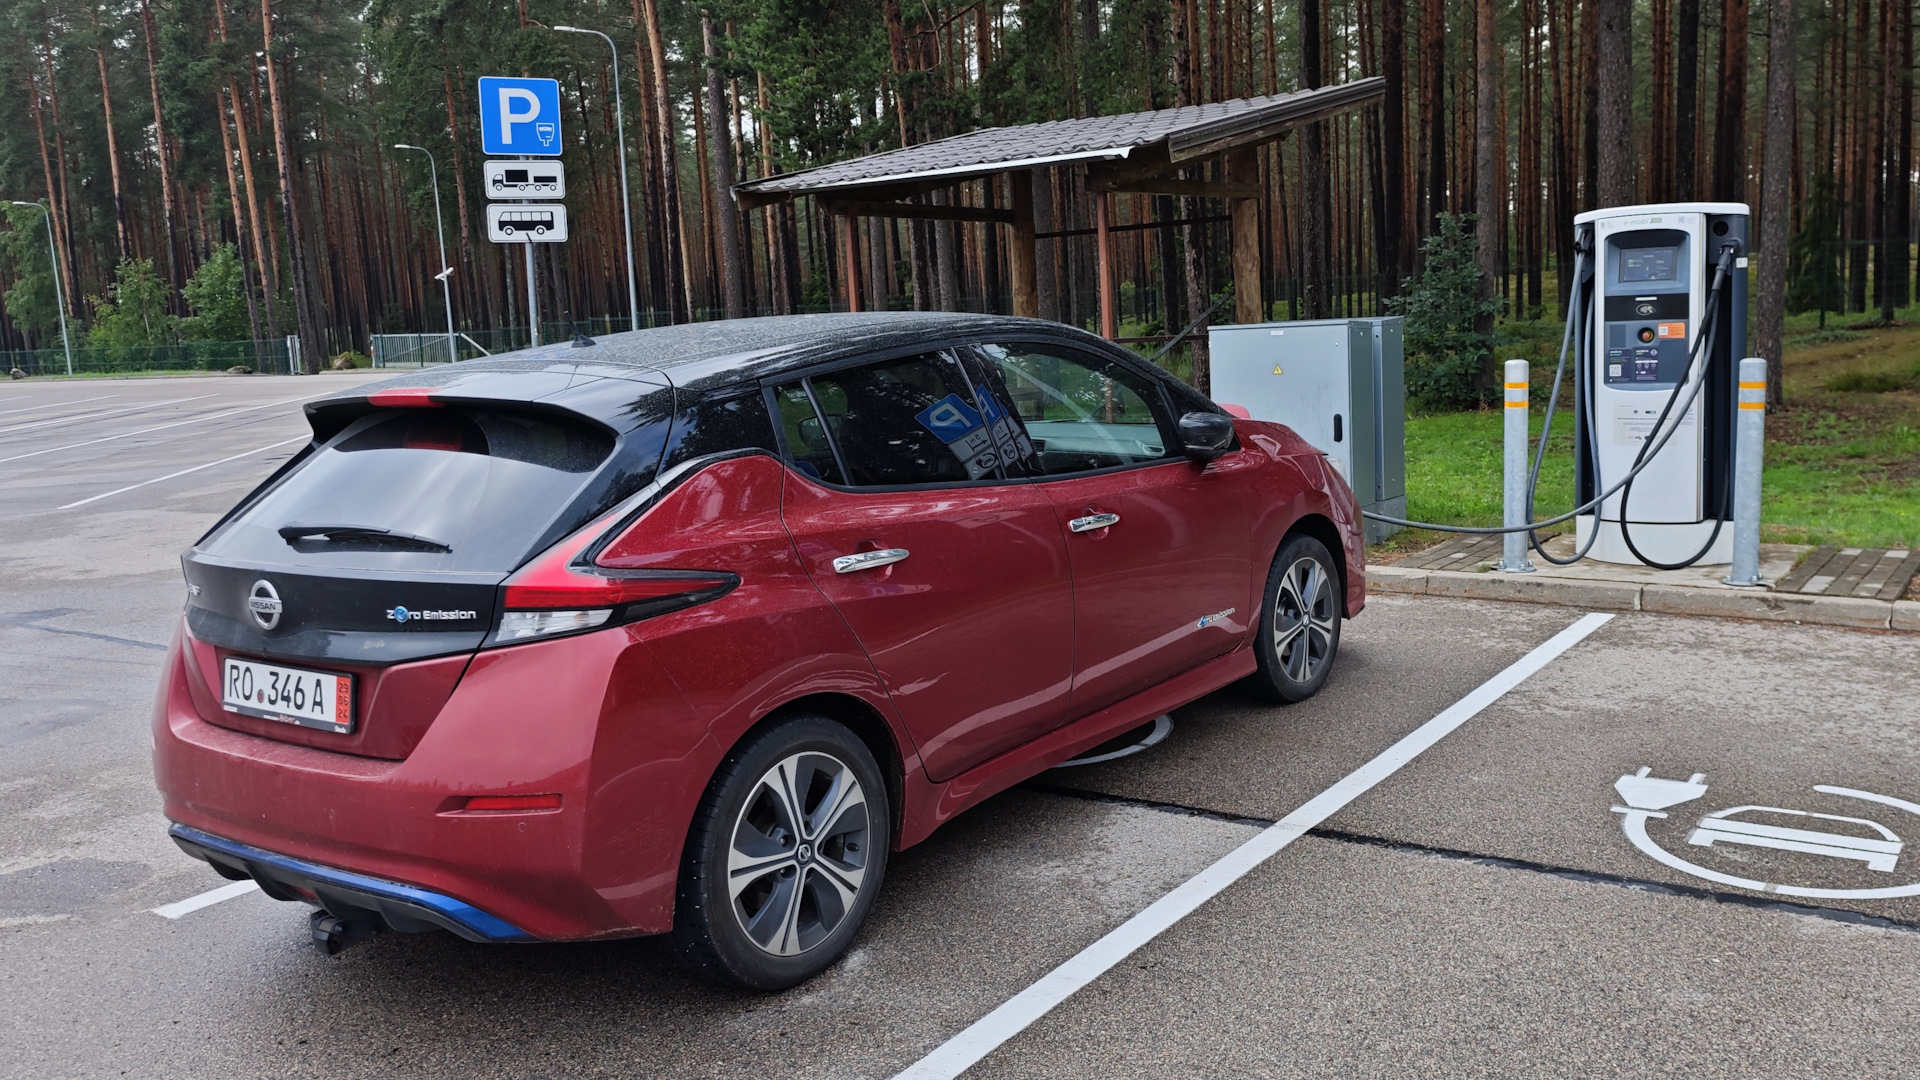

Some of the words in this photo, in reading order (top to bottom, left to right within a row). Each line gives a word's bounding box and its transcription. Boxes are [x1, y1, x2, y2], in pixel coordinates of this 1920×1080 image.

[499, 87, 541, 145] P
[250, 600, 276, 611] NISSAN
[422, 609, 477, 620] Emission
[229, 664, 254, 701] RO
[267, 671, 306, 711] 346
[311, 678, 324, 715] A
